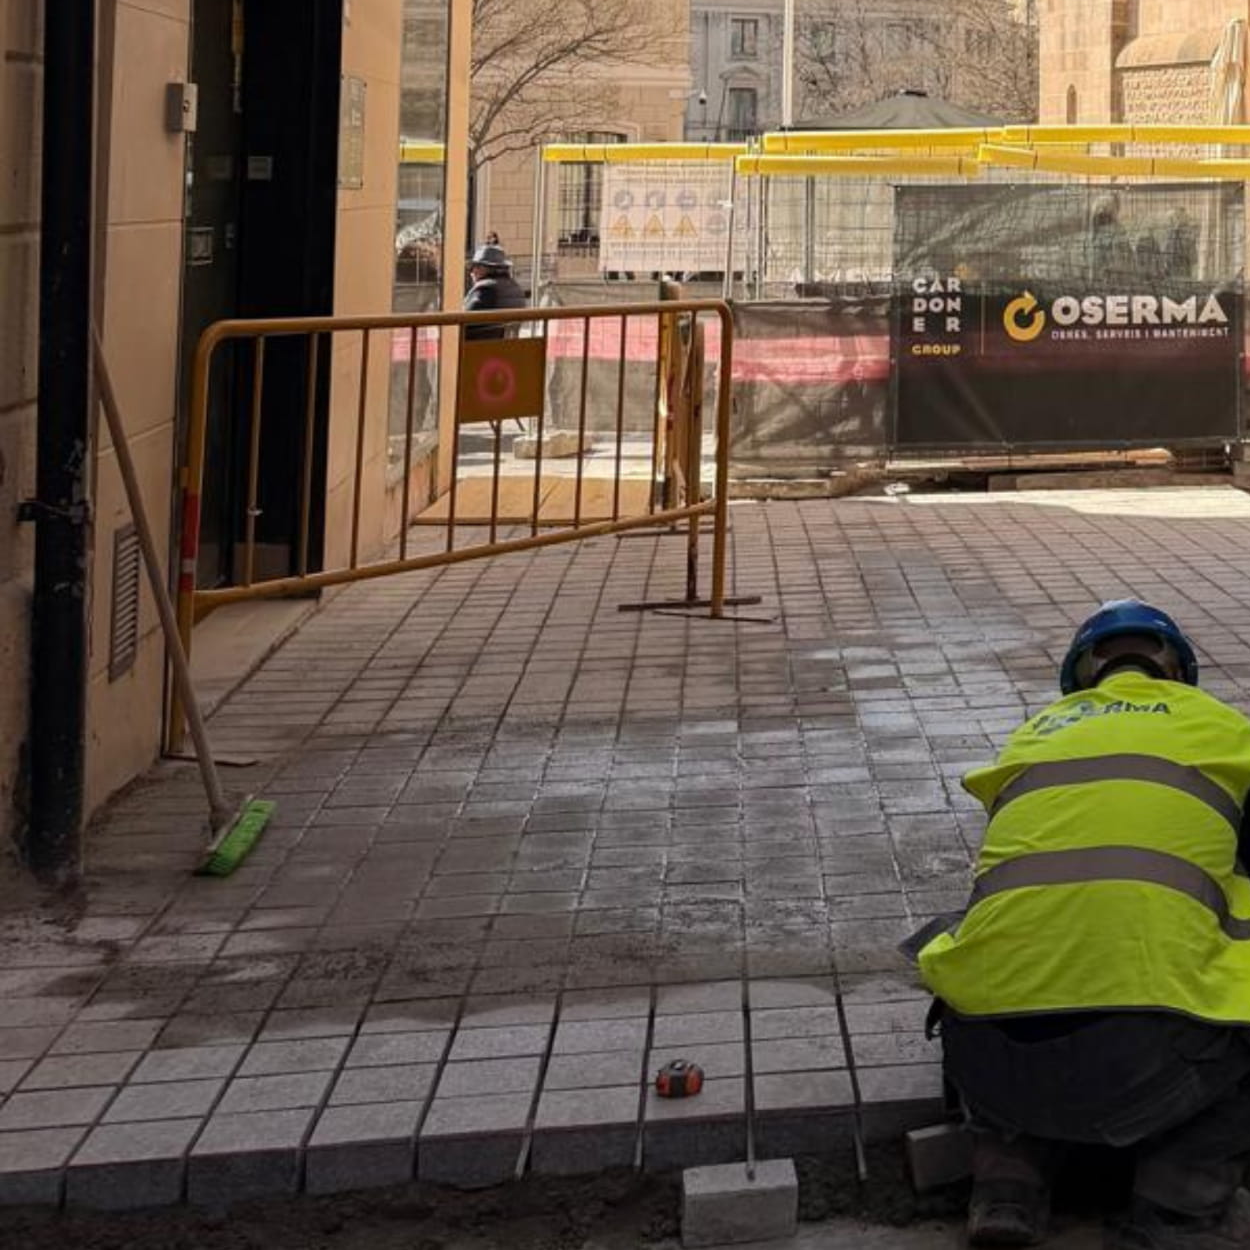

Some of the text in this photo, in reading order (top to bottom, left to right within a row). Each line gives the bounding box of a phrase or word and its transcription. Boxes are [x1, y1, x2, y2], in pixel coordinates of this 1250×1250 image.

[912, 276, 961, 293] CAR
[912, 297, 961, 313] DON
[1051, 294, 1229, 326] OSERMA
[911, 343, 961, 355] GROUP
